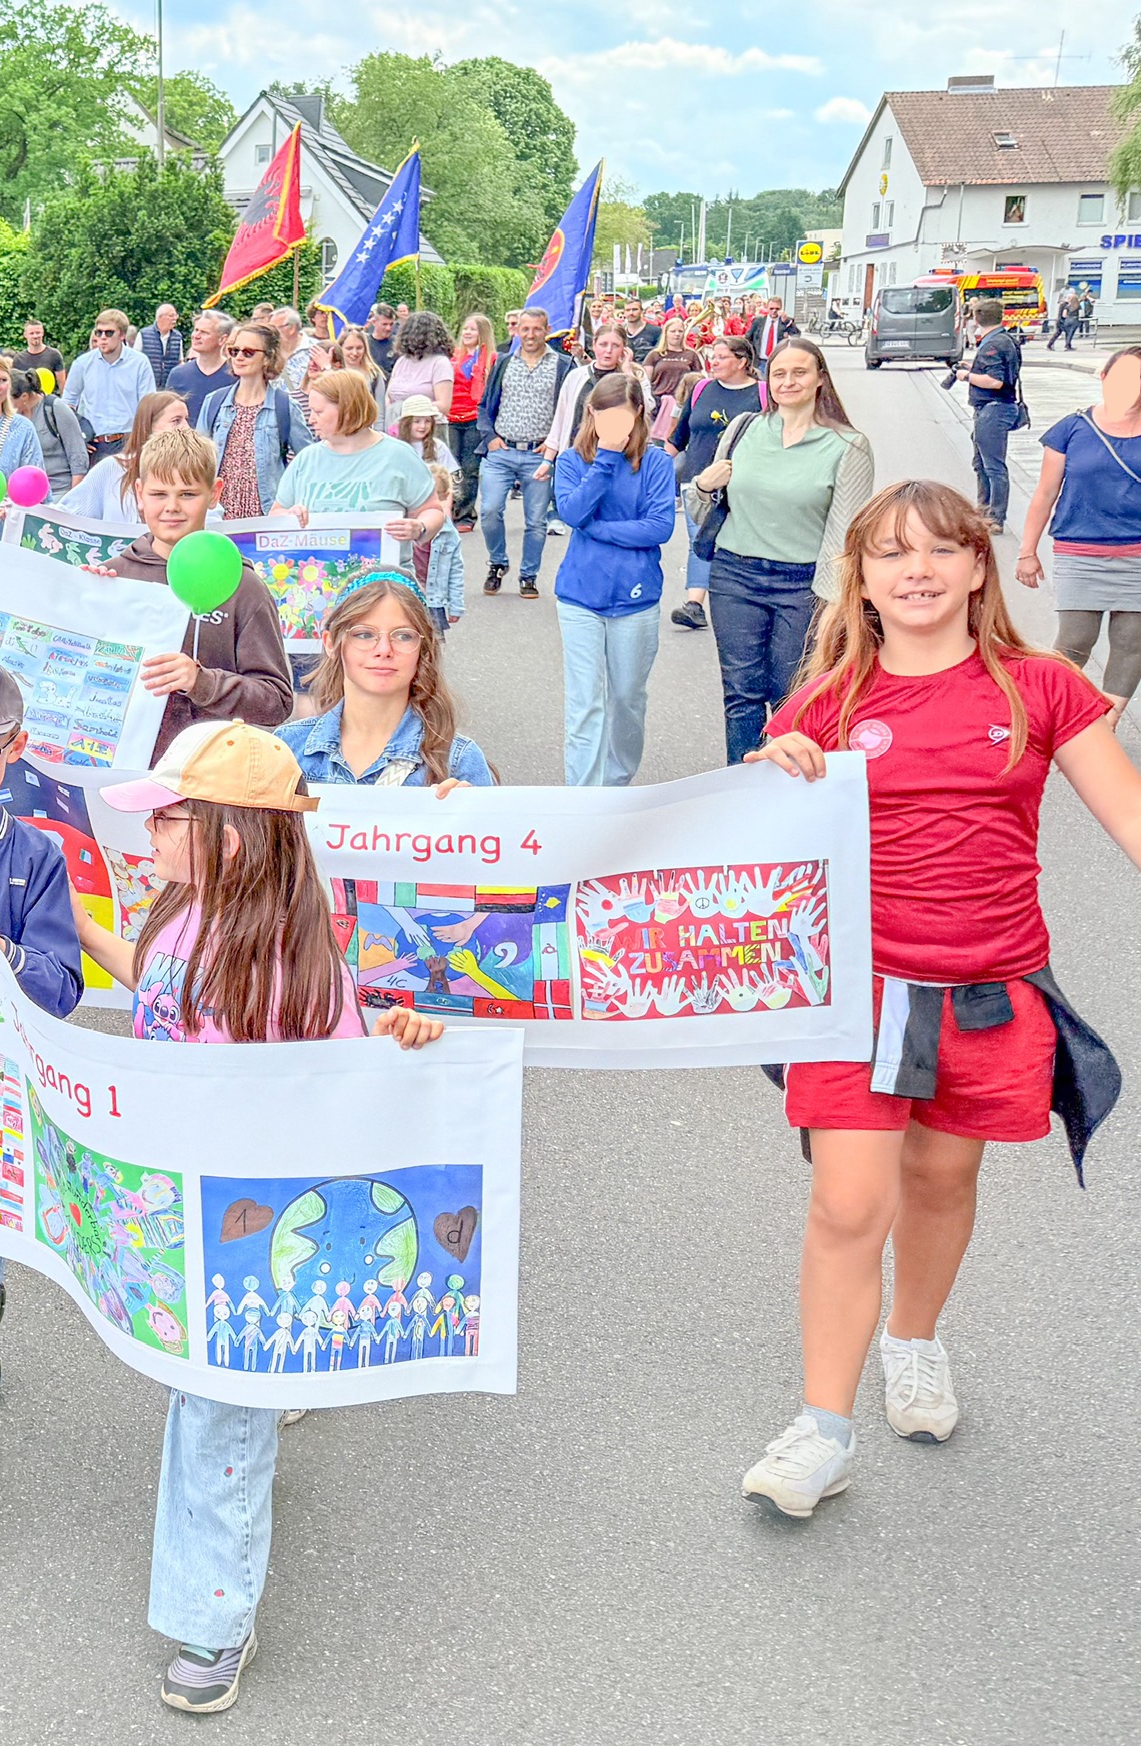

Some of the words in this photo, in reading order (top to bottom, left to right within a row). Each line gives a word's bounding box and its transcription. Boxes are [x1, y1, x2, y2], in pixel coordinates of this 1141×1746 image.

[630, 582, 643, 599] 6
[326, 823, 501, 864] Jahrgang
[520, 829, 542, 856] 4
[615, 927, 666, 950] WIR
[677, 919, 788, 947] HALTEN
[628, 941, 782, 975] ZUSAMMEN
[108, 1085, 122, 1118] 1
[234, 1208, 247, 1233] 1
[446, 1219, 464, 1244] d
